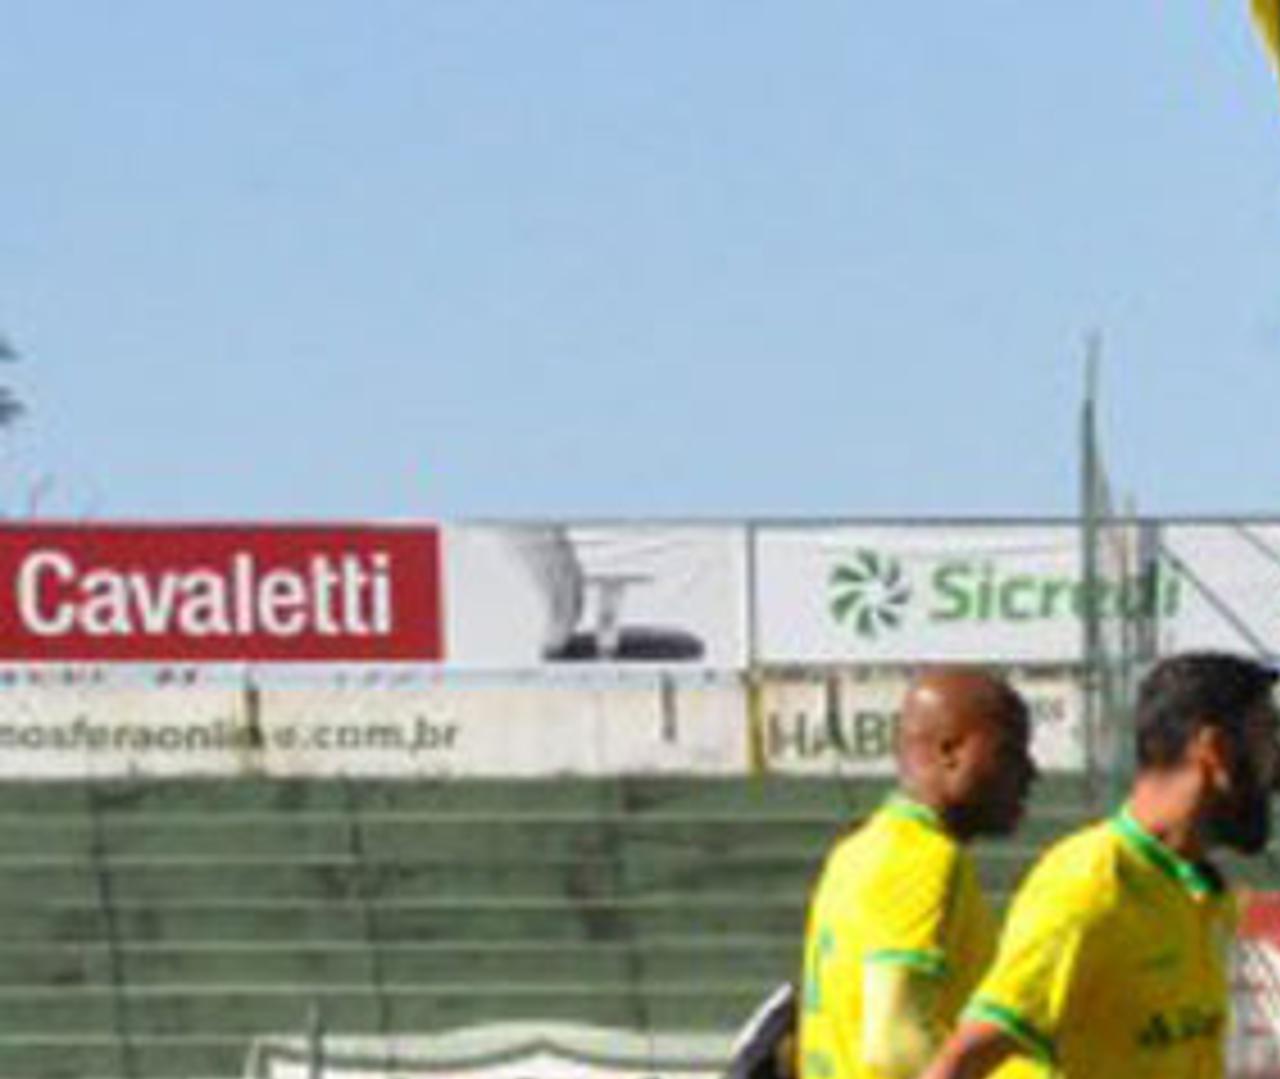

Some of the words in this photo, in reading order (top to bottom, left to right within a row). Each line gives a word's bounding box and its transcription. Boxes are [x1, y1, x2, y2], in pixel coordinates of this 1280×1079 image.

[15, 550, 392, 636] Cavaletti
[929, 557, 1181, 620] Sicredi
[0, 714, 460, 755] osferaonlie.com.br
